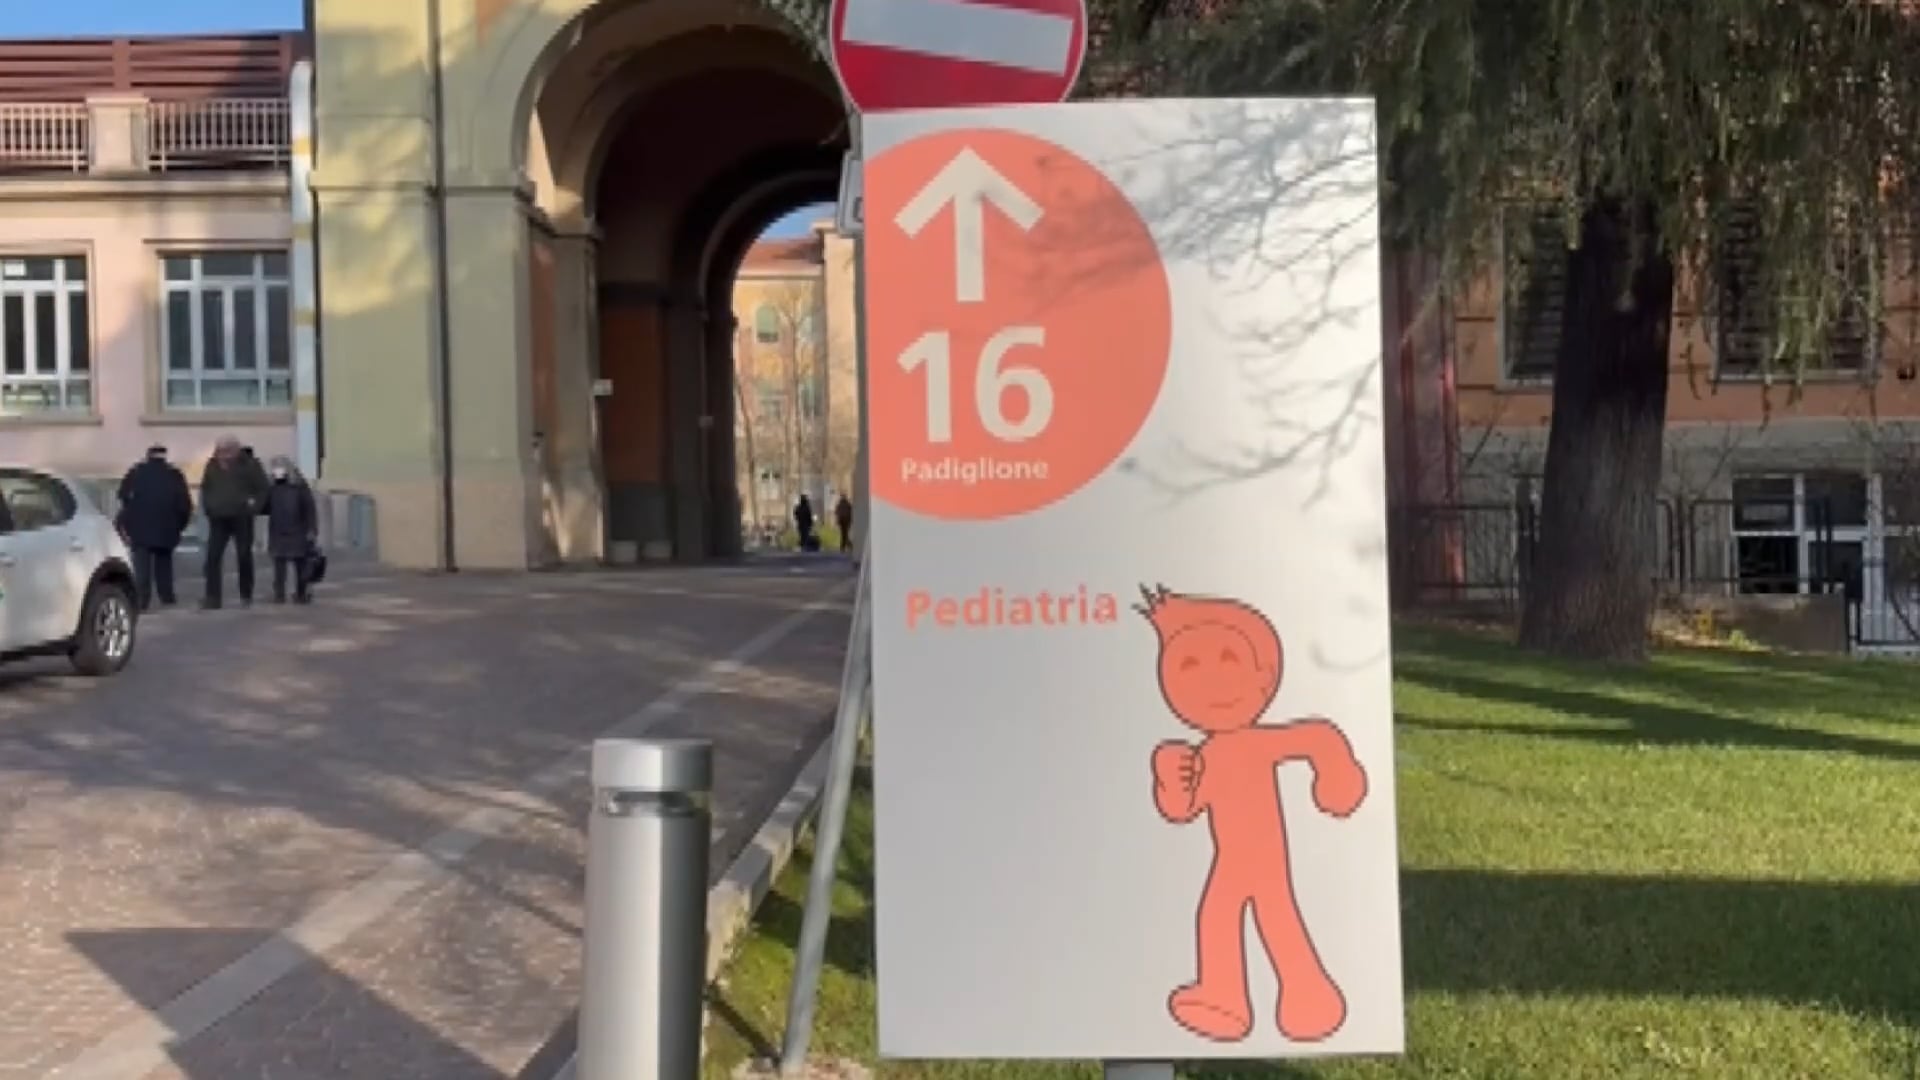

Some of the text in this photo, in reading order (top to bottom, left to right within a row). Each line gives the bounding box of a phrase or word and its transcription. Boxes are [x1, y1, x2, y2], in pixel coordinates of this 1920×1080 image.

[898, 327, 1054, 443] 16
[901, 456, 1050, 484] Padiglione
[905, 584, 1118, 629] Pediatria
